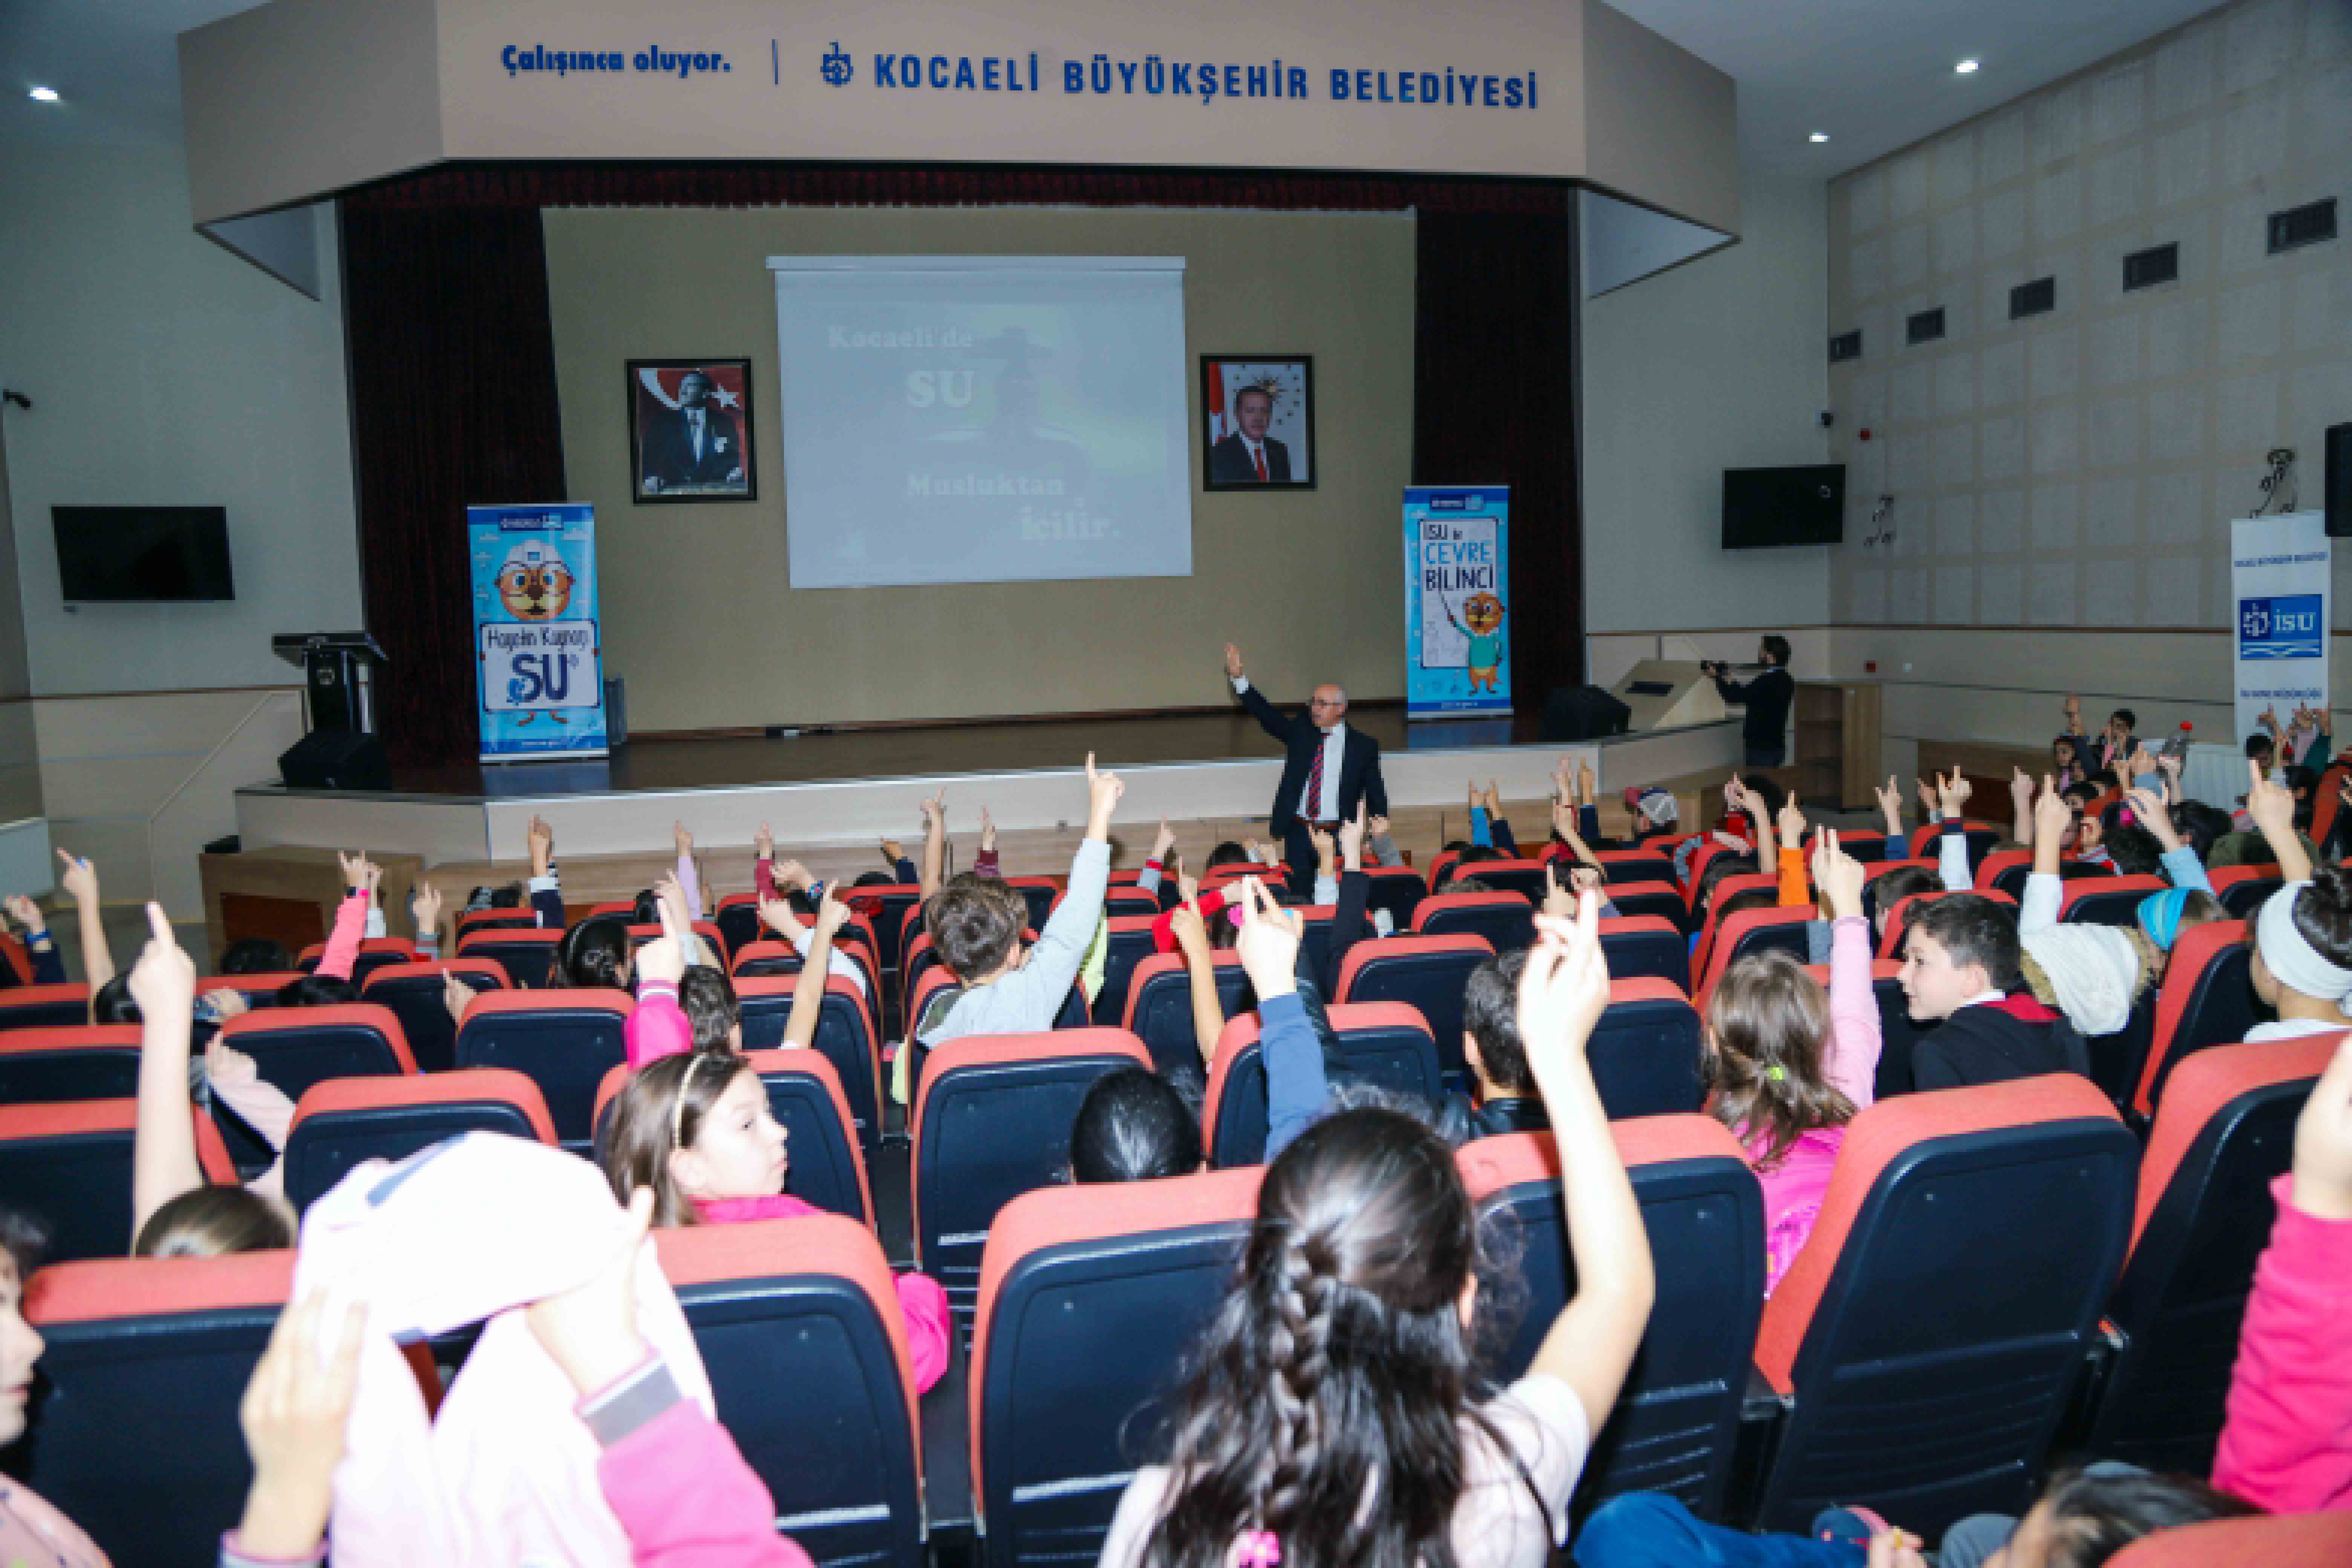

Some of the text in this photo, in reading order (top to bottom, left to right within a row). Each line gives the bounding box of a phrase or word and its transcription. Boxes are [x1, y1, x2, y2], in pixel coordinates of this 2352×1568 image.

[501, 44, 731, 78] Çalışınca oluyor.
[874, 52, 1538, 109] KOCAELİ BÜYÜKŞEHİR BELEDİYESİ
[828, 325, 975, 348] Kocaeli'de
[906, 371, 975, 407] SU
[906, 473, 1066, 497] Musluktan
[507, 652, 568, 703] SU
